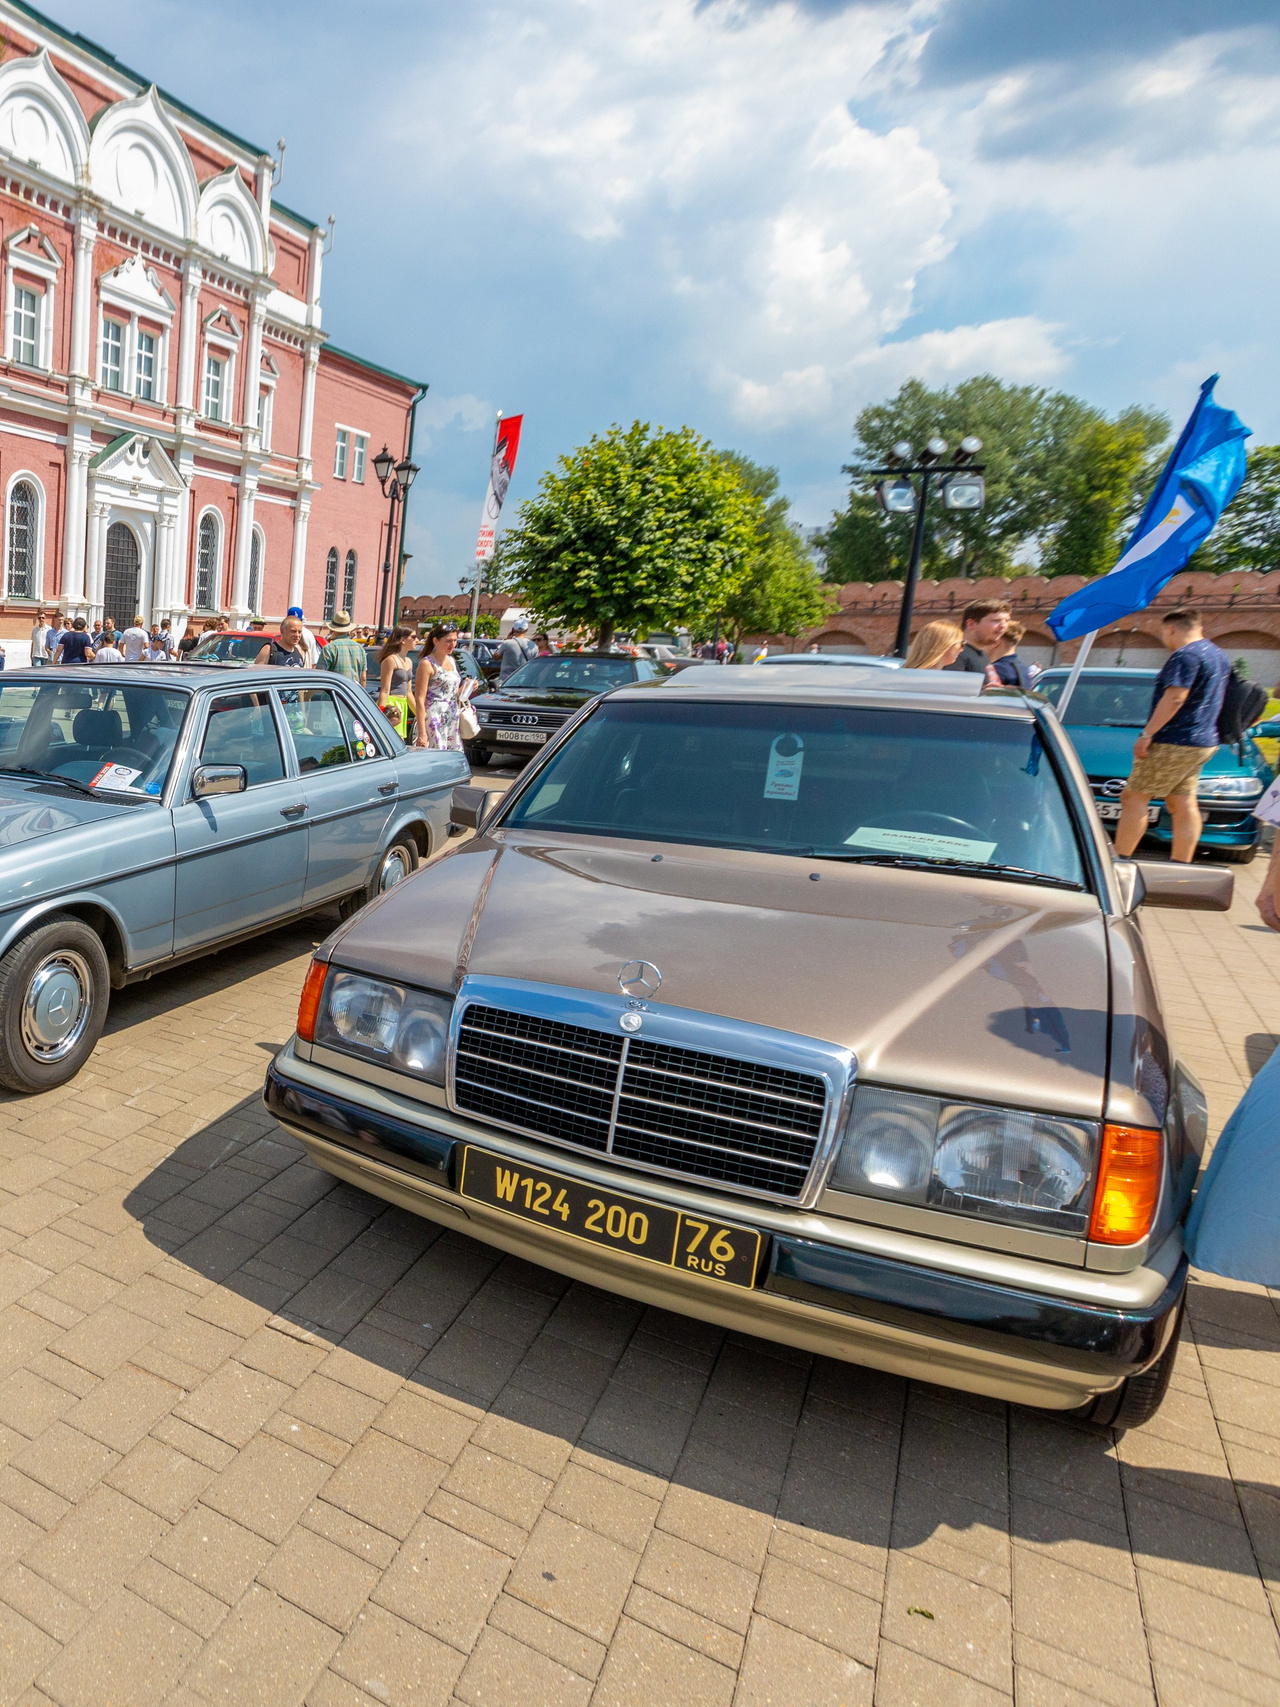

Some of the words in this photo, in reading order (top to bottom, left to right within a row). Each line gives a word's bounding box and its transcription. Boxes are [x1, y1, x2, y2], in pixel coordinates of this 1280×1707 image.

[882, 833, 935, 842] DAIMLER
[495, 1166, 570, 1222] W124
[584, 1199, 649, 1245] 200
[684, 1218, 735, 1262] 76
[687, 1254, 727, 1277] RUS
